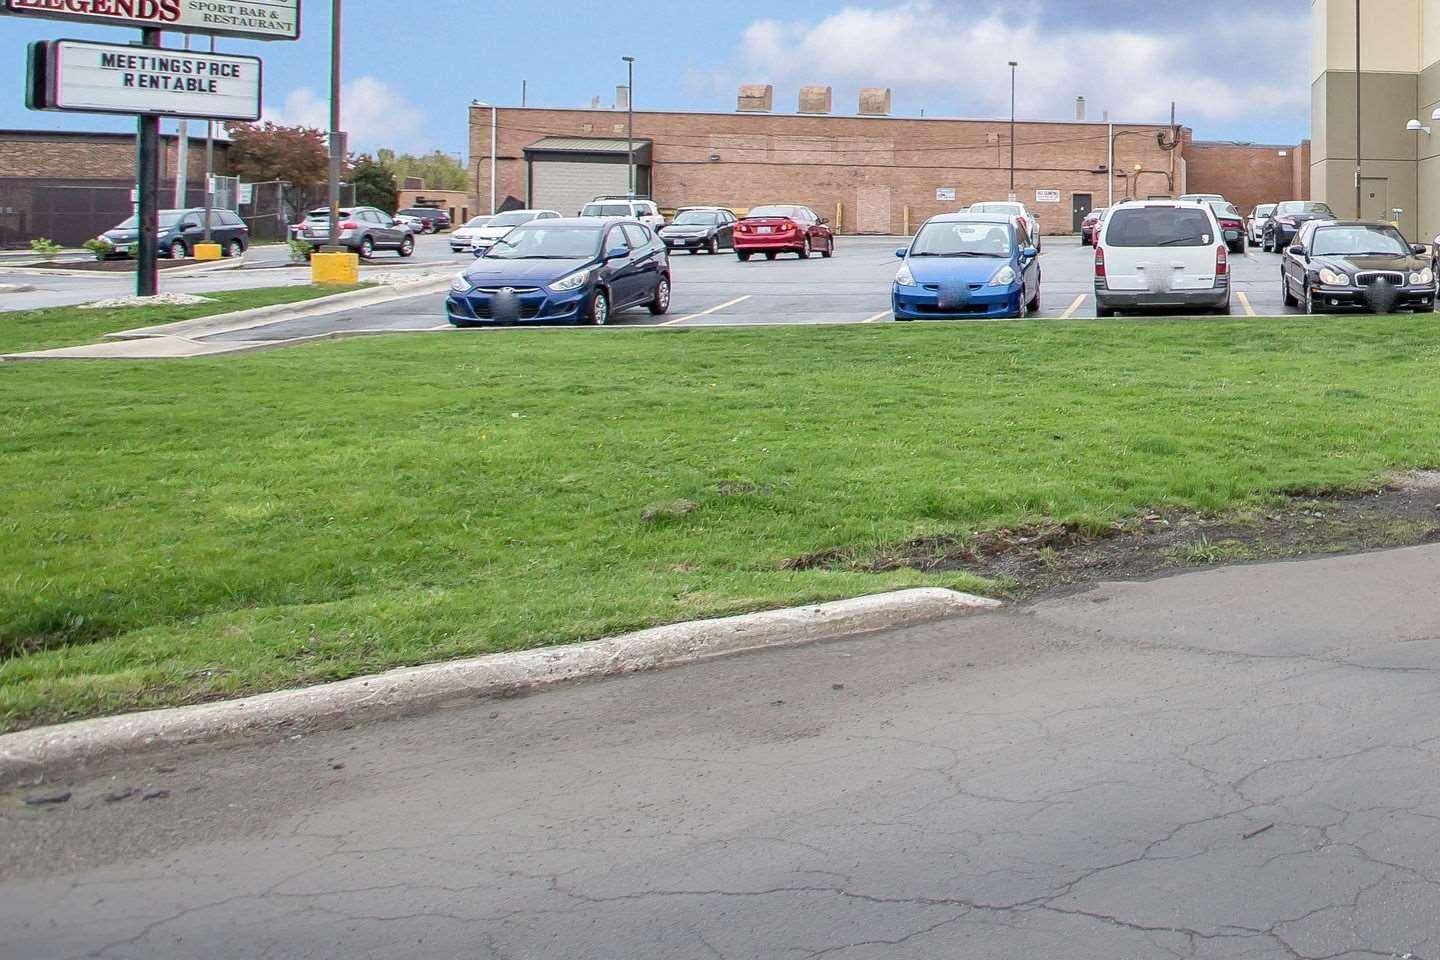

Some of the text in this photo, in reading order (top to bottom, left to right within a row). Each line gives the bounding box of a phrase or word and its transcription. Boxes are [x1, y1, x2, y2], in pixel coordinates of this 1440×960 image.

[188, 0, 279, 19] SPORT BAR &
[203, 13, 294, 31] RESTAURANT
[124, 73, 217, 93] RENTABLE
